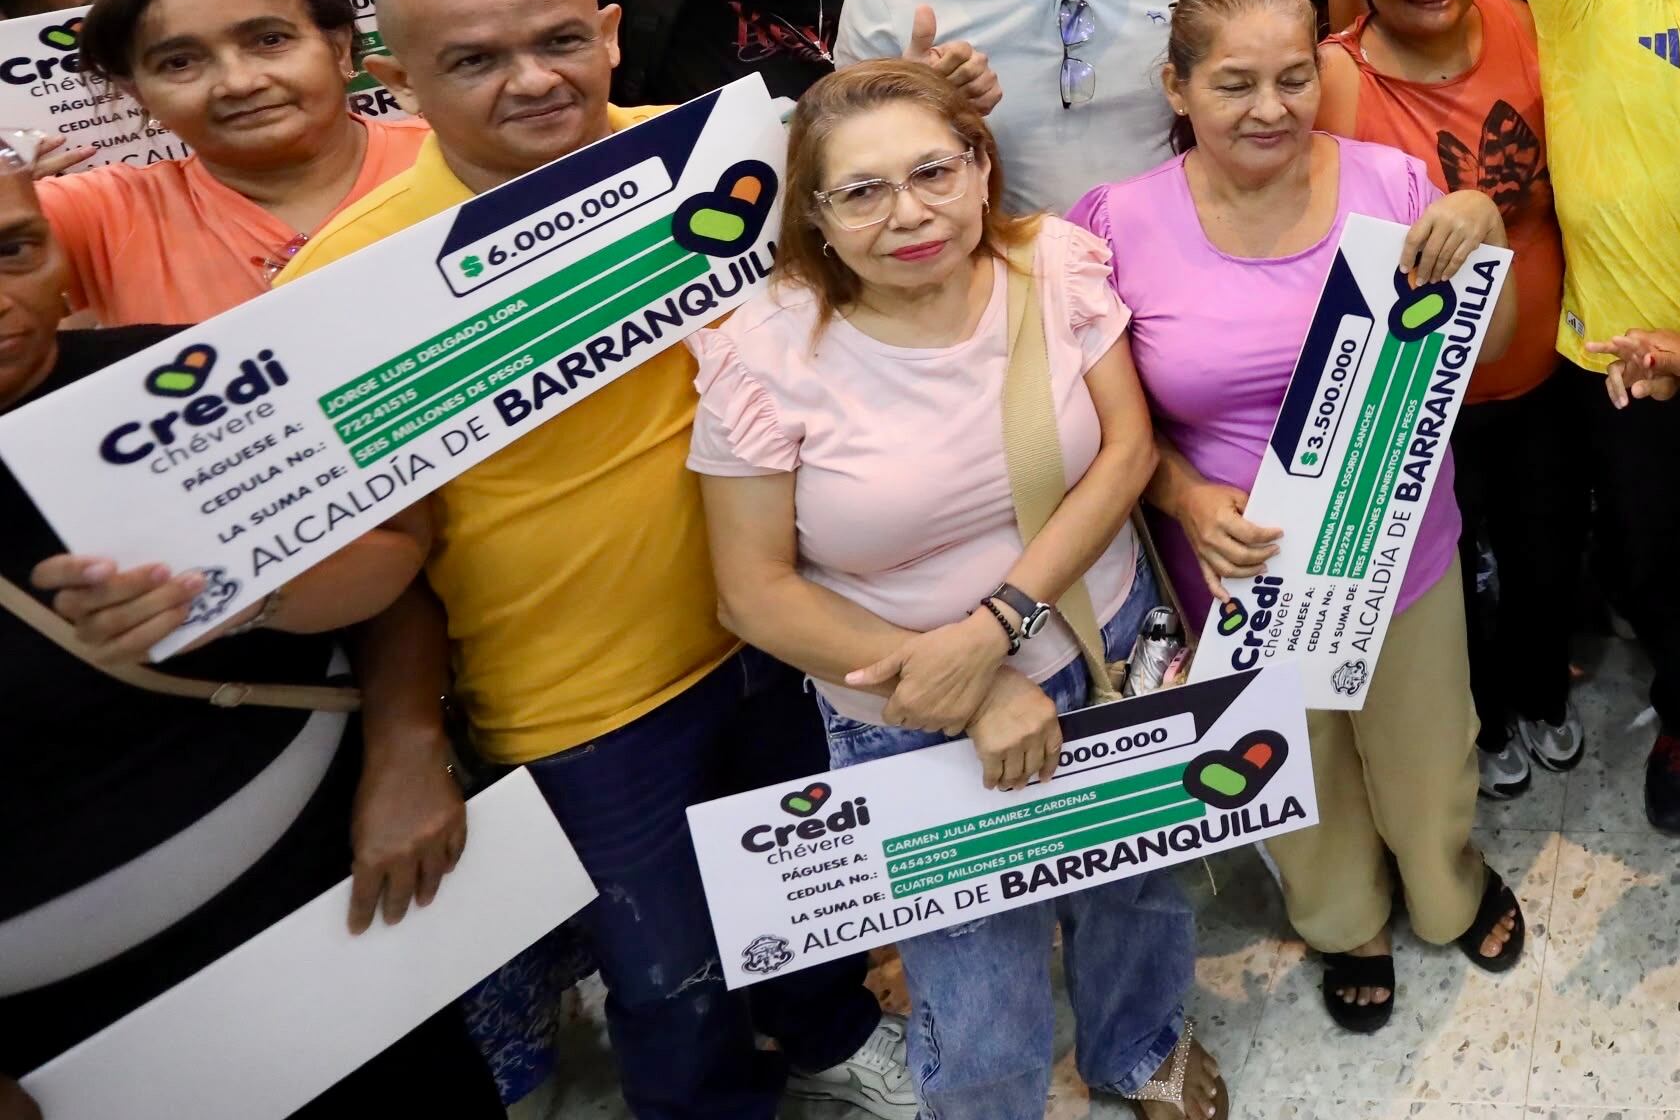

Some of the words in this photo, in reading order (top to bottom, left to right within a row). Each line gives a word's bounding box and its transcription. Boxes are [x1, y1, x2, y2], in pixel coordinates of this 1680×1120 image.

[0, 52, 83, 85] Cre
[30, 74, 104, 97] chéve
[58, 112, 123, 133] CEDULA
[326, 377, 380, 414] JORGE
[380, 358, 417, 383] LUIS
[416, 320, 488, 363] DELGADO
[488, 299, 529, 324] LORA
[1394, 260, 1501, 502] BARRANQUILLA
[100, 349, 289, 465] Credi
[251, 453, 435, 577] ALCALDÍA
[441, 416, 490, 457] DE
[493, 241, 776, 427] BARRANQUIL
[339, 388, 418, 437] 72241515
[355, 437, 390, 462] SEIS
[391, 393, 466, 441] MILLONES
[466, 381, 489, 398] DE
[488, 354, 534, 385] PESOS
[1402, 399, 1418, 429] PESOS
[150, 401, 276, 474] chévere
[183, 432, 277, 492] PÁGUESE
[284, 422, 304, 438] A:
[1397, 431, 1408, 447] MIL
[201, 466, 283, 515] CEDULA
[1312, 523, 1336, 574] GERMANIA
[1329, 489, 1347, 521] ISABEL
[1341, 450, 1360, 486] OSORIO
[1355, 404, 1376, 449] SANCHEZ
[1376, 449, 1401, 506] QUINIENTOS
[217, 525, 246, 545] LA
[249, 486, 313, 526] SUMA
[316, 465, 349, 488] DE:
[1387, 510, 1412, 538] DE
[1332, 524, 1356, 576] 32692748
[1362, 507, 1382, 554] MILLONES
[1352, 555, 1366, 577] TRES
[1231, 575, 1284, 671] Credi
[1351, 546, 1400, 653] ALCALDÍA
[1263, 592, 1294, 658] chévere
[1287, 601, 1310, 651] PÁGUESE
[1307, 609, 1328, 652] CEDULA
[1328, 642, 1338, 654] LA
[1334, 604, 1352, 640] SUMA
[1058, 727, 1168, 768] 000.000
[741, 796, 871, 854] Credi
[885, 831, 940, 853] CARMEN
[942, 823, 976, 842] JULIA
[979, 808, 1031, 829] RAMIREZ
[1034, 791, 1097, 814] CARDENAS
[767, 834, 855, 865] chévere
[781, 857, 849, 882] PÁGUESE
[853, 853, 868, 864] A:
[802, 896, 945, 954] ALCALDÍA
[954, 884, 991, 910] DE
[1000, 795, 1307, 899] BARRANQUILLA
[890, 848, 958, 872] 64543903
[894, 874, 944, 894] CUATRO
[948, 856, 1006, 880] MILLONES
[1008, 851, 1025, 863] DE
[1027, 841, 1065, 858] PESOS
[786, 879, 845, 902] CEDULA
[791, 913, 810, 925] LA
[813, 900, 859, 918] SUMA
[862, 891, 886, 904] DE:
